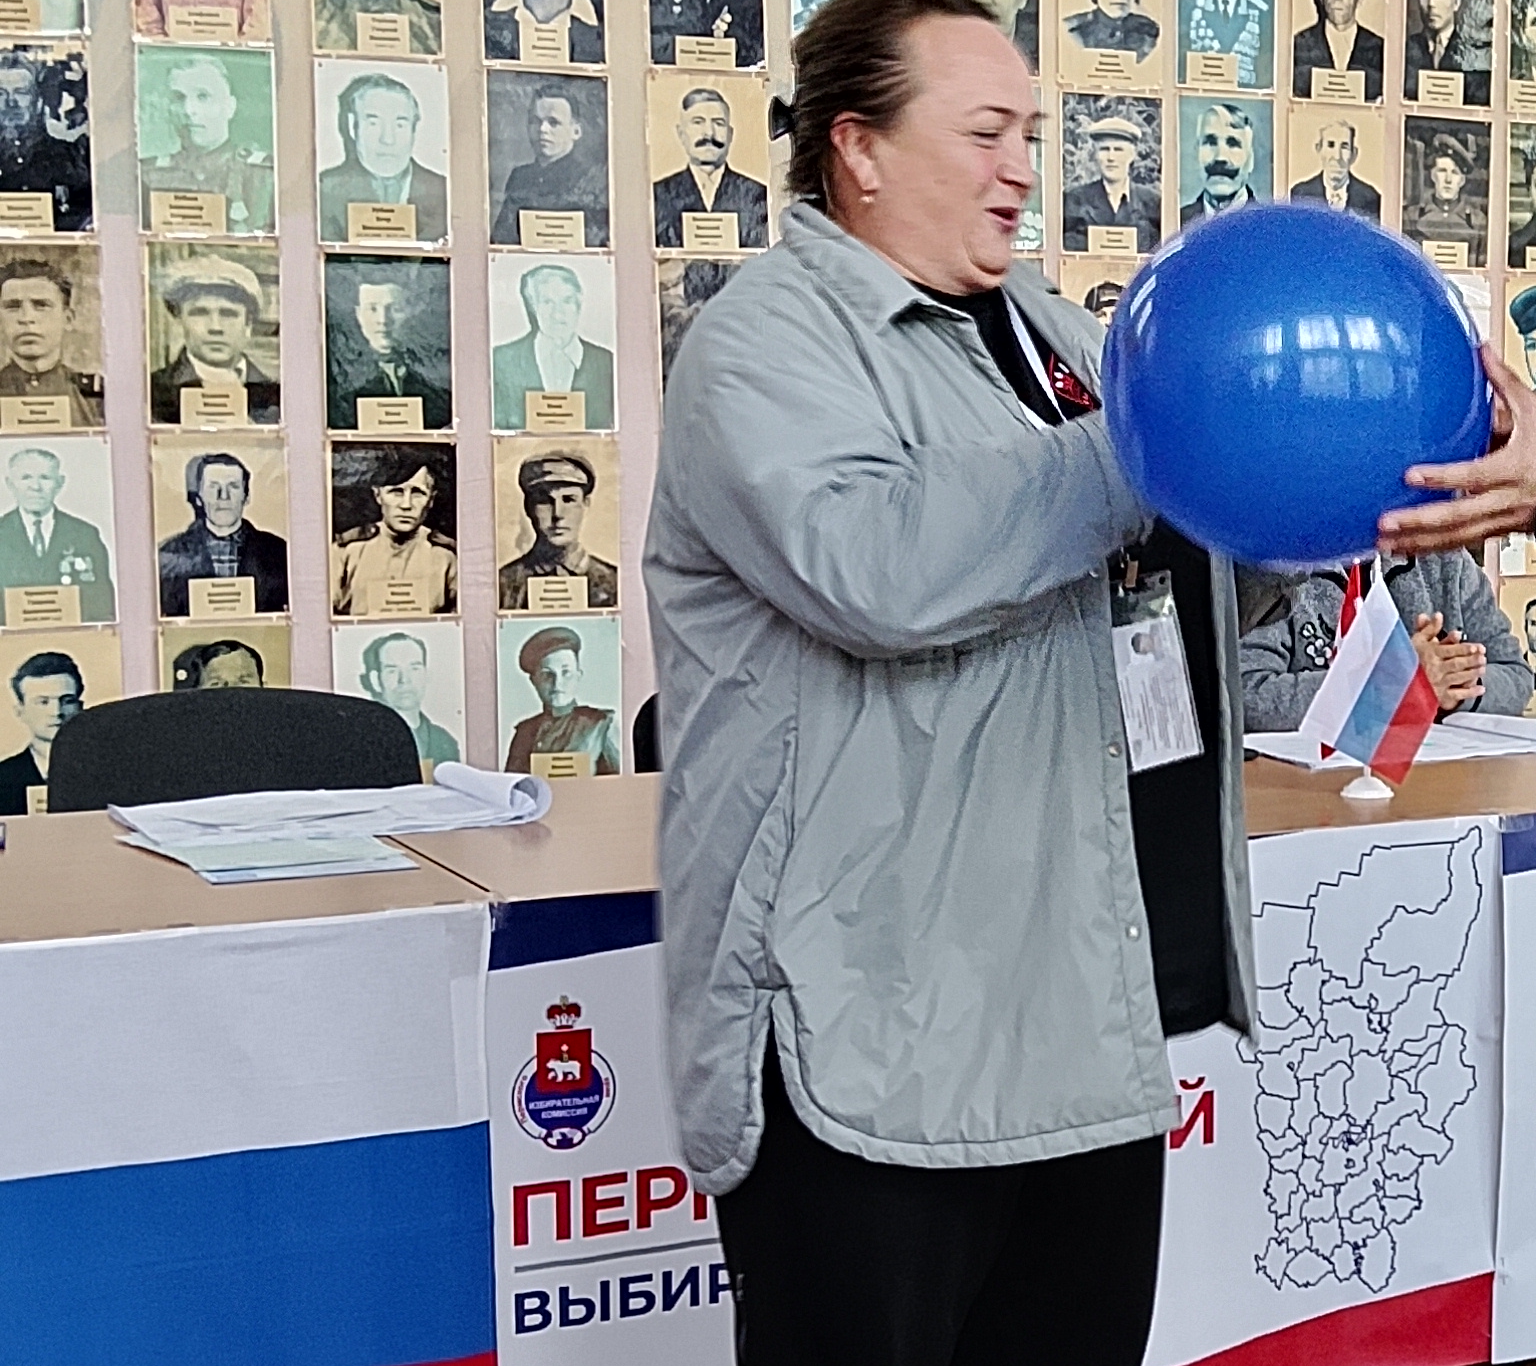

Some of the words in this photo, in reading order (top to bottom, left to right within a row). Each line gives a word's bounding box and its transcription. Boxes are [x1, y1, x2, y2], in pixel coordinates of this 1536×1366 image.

[529, 1094, 600, 1110] ИЗБИРАТЕЛЬНАЯ
[513, 1166, 708, 1246] ПЕР
[515, 1263, 734, 1335] ВЫБИР
